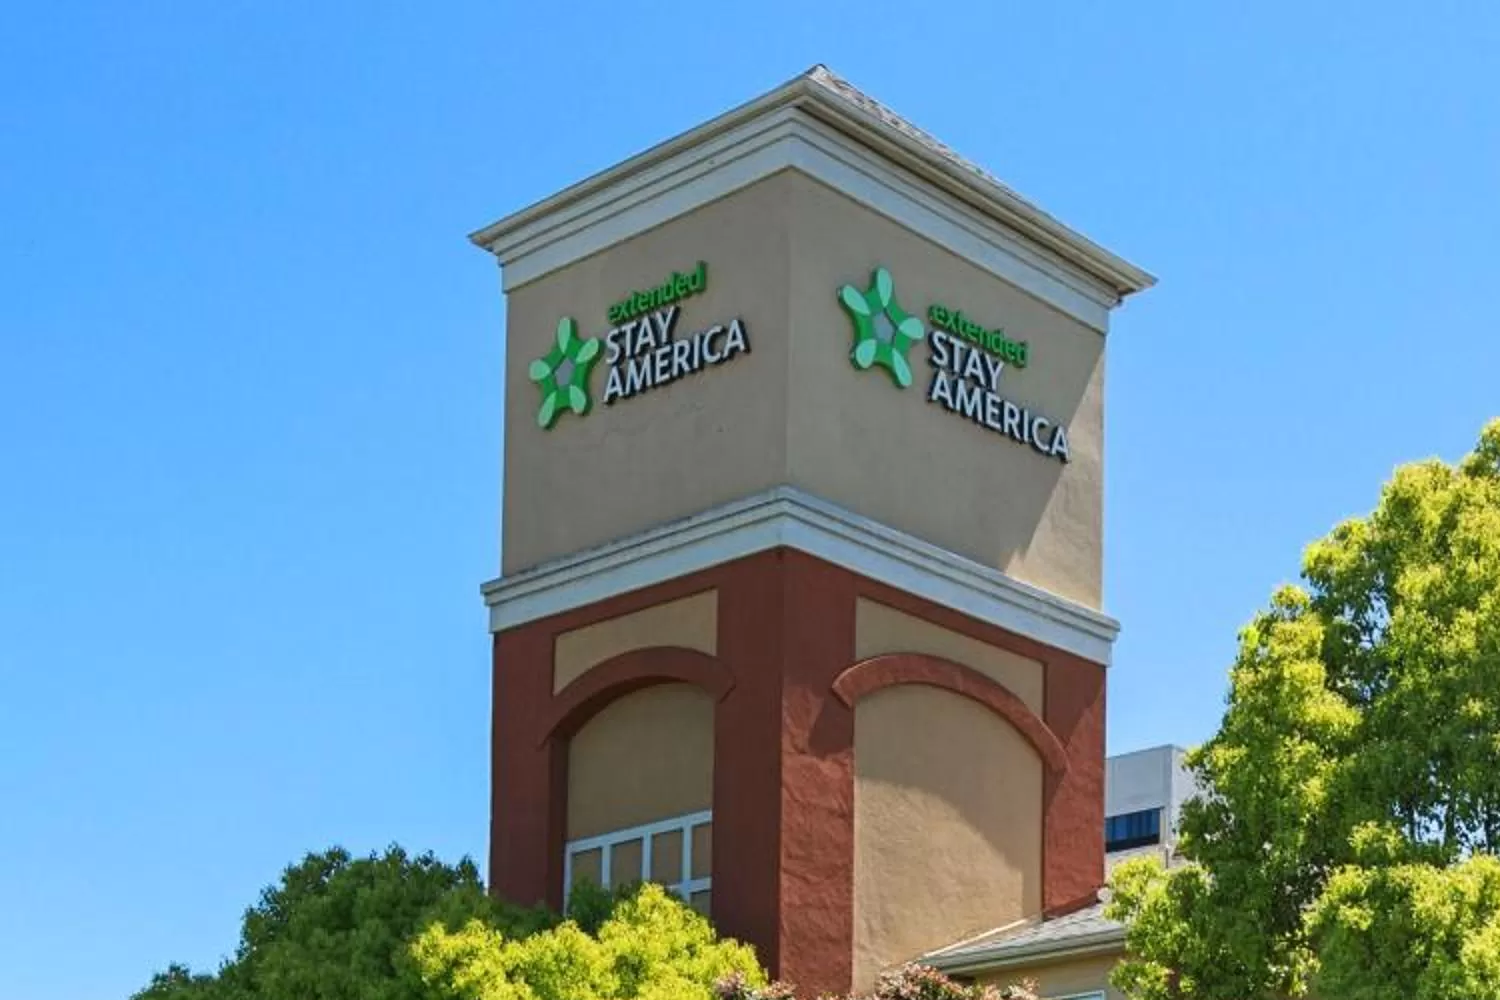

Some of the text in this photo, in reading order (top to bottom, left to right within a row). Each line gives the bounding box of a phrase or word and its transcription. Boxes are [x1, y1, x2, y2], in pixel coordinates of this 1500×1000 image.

[607, 261, 707, 323] extended
[603, 319, 749, 403] AMERICA
[606, 306, 677, 364] STAY
[928, 305, 1027, 367] extended
[930, 331, 1004, 391] STAY
[929, 369, 1070, 462] AMERICA
